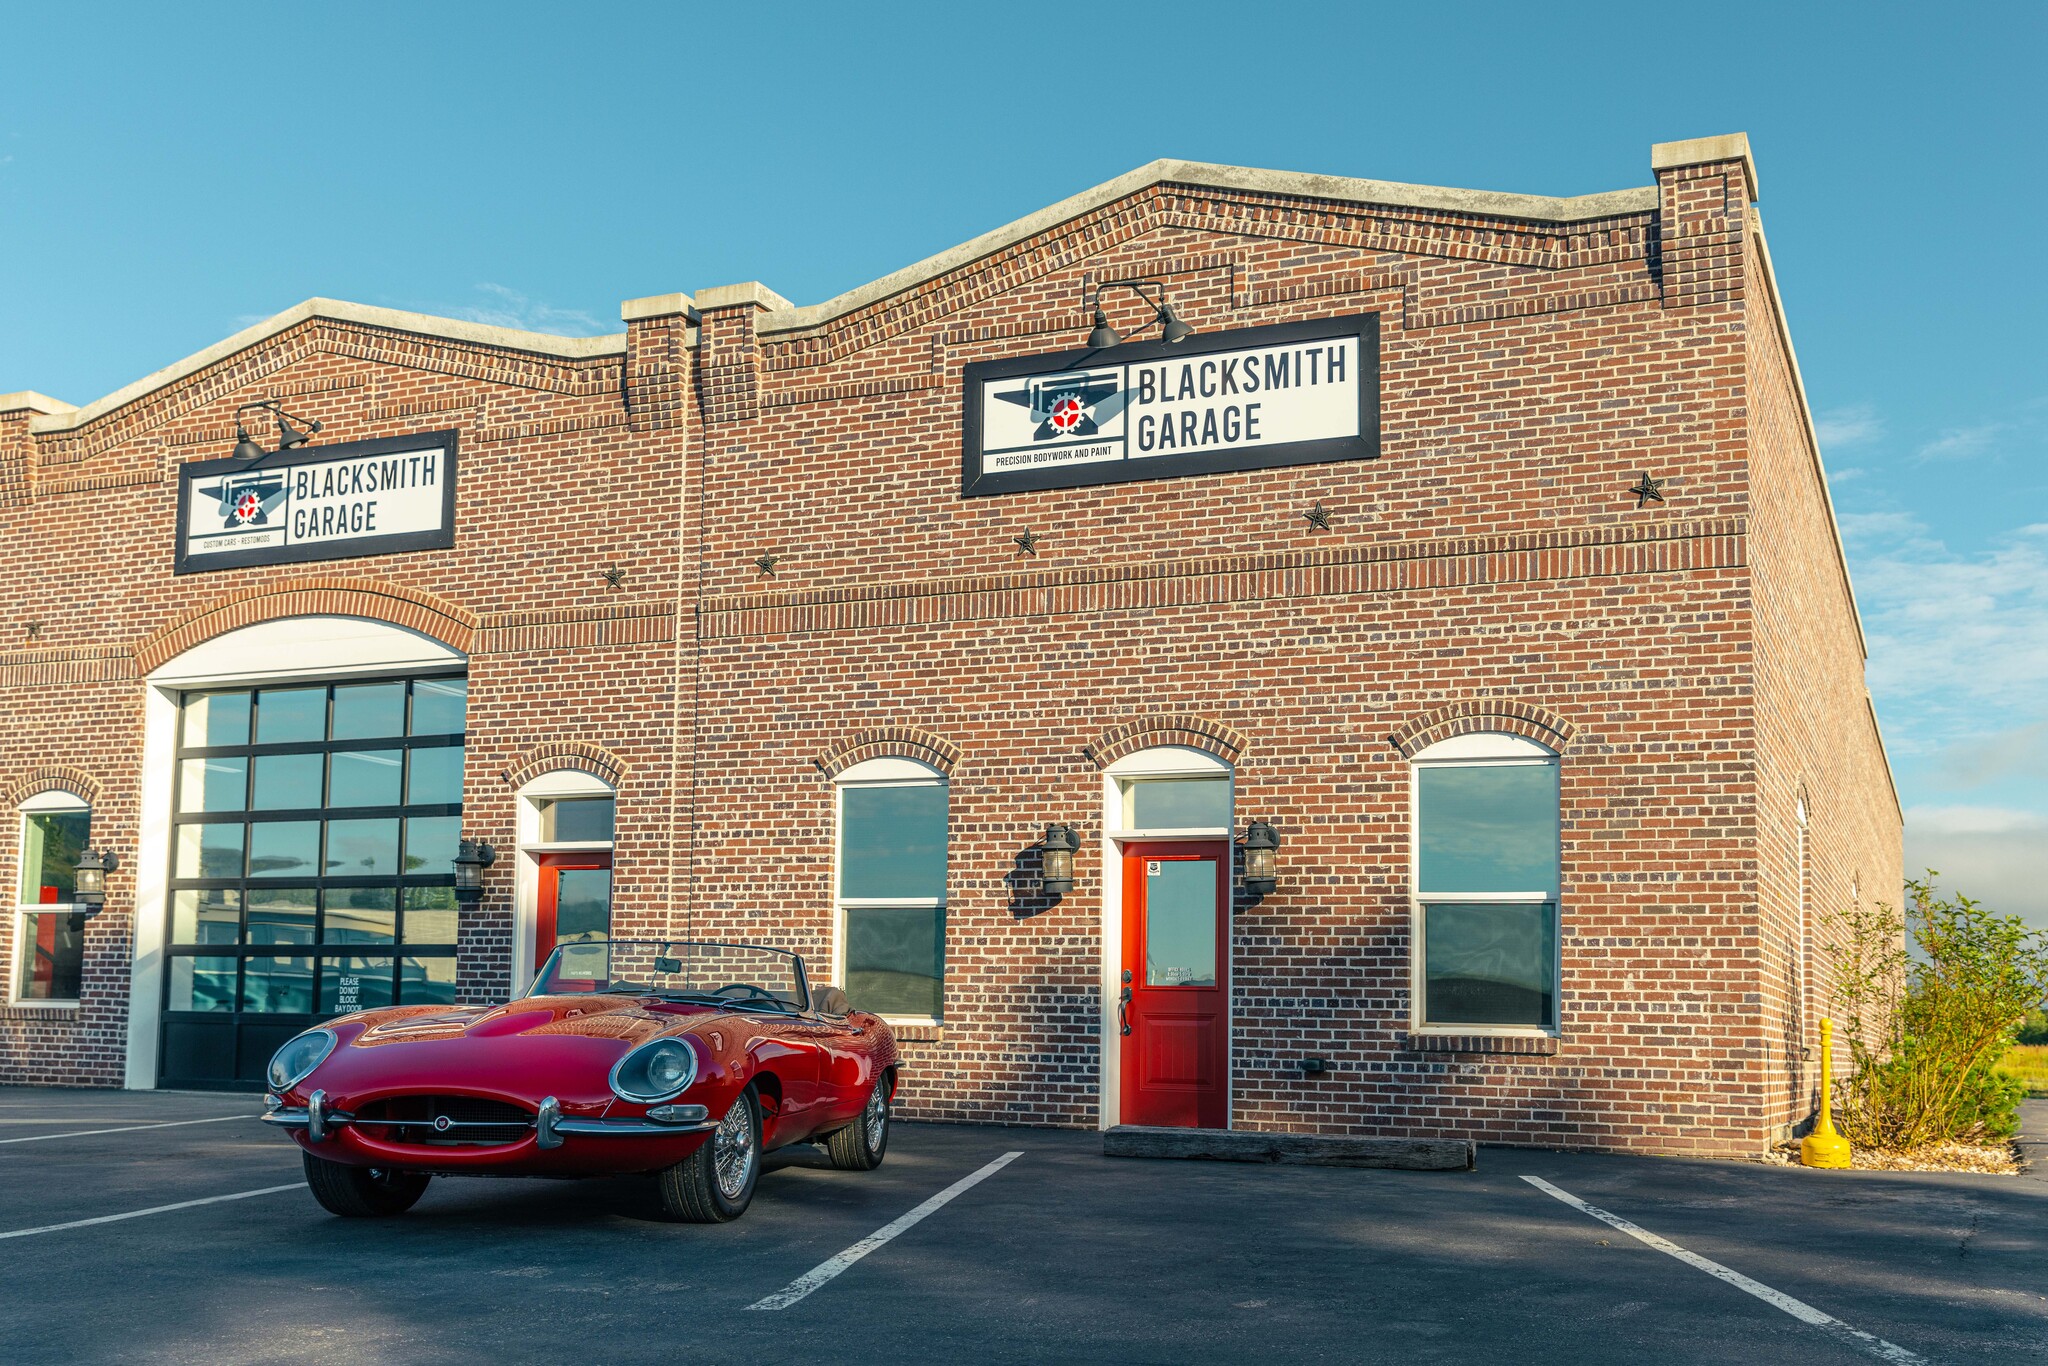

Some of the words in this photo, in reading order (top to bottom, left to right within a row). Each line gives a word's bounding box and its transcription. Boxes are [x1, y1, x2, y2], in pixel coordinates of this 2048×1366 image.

[1139, 345, 1345, 405] BLACKSMITH
[1138, 402, 1261, 452] GARAGE
[996, 454, 1032, 467] PRECISION
[1033, 450, 1073, 463] BODYWORK
[1074, 447, 1089, 459] AND
[1090, 445, 1112, 457] PAINT
[296, 455, 436, 501] BLACKSMITH
[294, 501, 378, 539] GARAGE
[204, 540, 223, 548] CUSTOM
[224, 538, 236, 546] CARS
[241, 535, 270, 544] RESTOMODS
